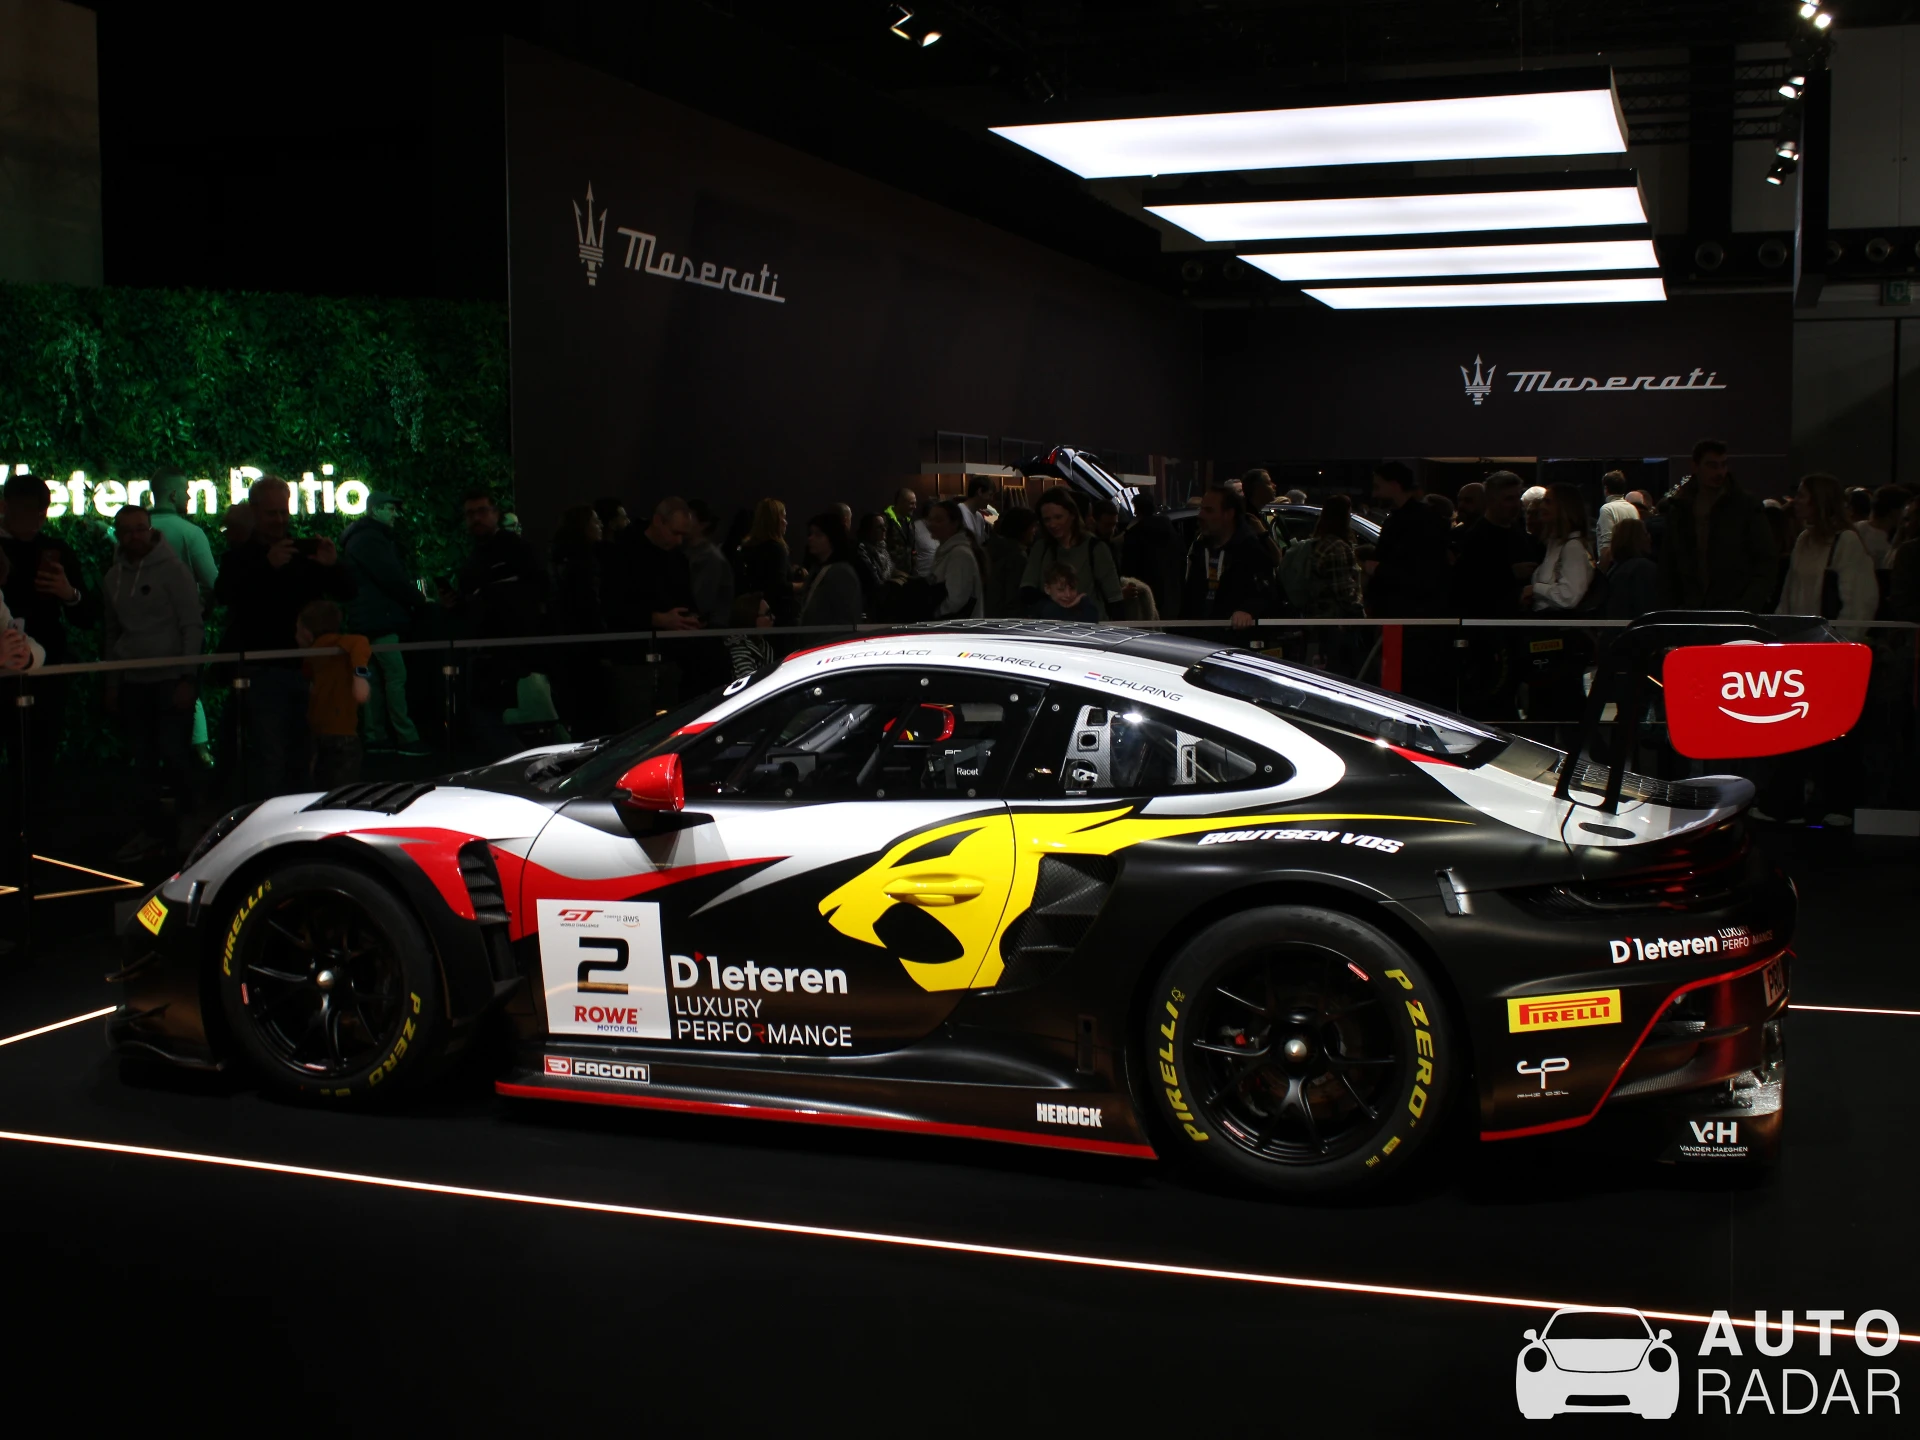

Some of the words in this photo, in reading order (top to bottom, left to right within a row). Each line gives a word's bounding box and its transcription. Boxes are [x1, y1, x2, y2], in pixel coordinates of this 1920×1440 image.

[616, 226, 786, 304] Maserati
[1506, 357, 1728, 393] Maserati
[230, 463, 370, 515] Ptio
[970, 652, 1062, 672] PICARIELLO
[1099, 675, 1184, 702] SCHURING
[1721, 669, 1805, 700] aws
[1198, 829, 1340, 847] BOUTSEN
[1340, 833, 1405, 854] VDS
[222, 884, 265, 977] PIRELLI
[577, 936, 630, 995] 2
[573, 1005, 638, 1025] ROWE
[674, 996, 763, 1019] LUXURY
[1519, 996, 1611, 1025] PIRELLI
[597, 1025, 622, 1033] MOTOR
[624, 1026, 639, 1034] OIL
[677, 1020, 853, 1047] PERFORMANCE
[367, 1017, 417, 1088] ZERO
[1404, 999, 1434, 1120] ZERO
[574, 1061, 647, 1081] FACOM
[1157, 1001, 1209, 1142] PIRELLI
[1036, 1103, 1102, 1128] HEROCK
[1680, 1145, 1711, 1153] VANDER
